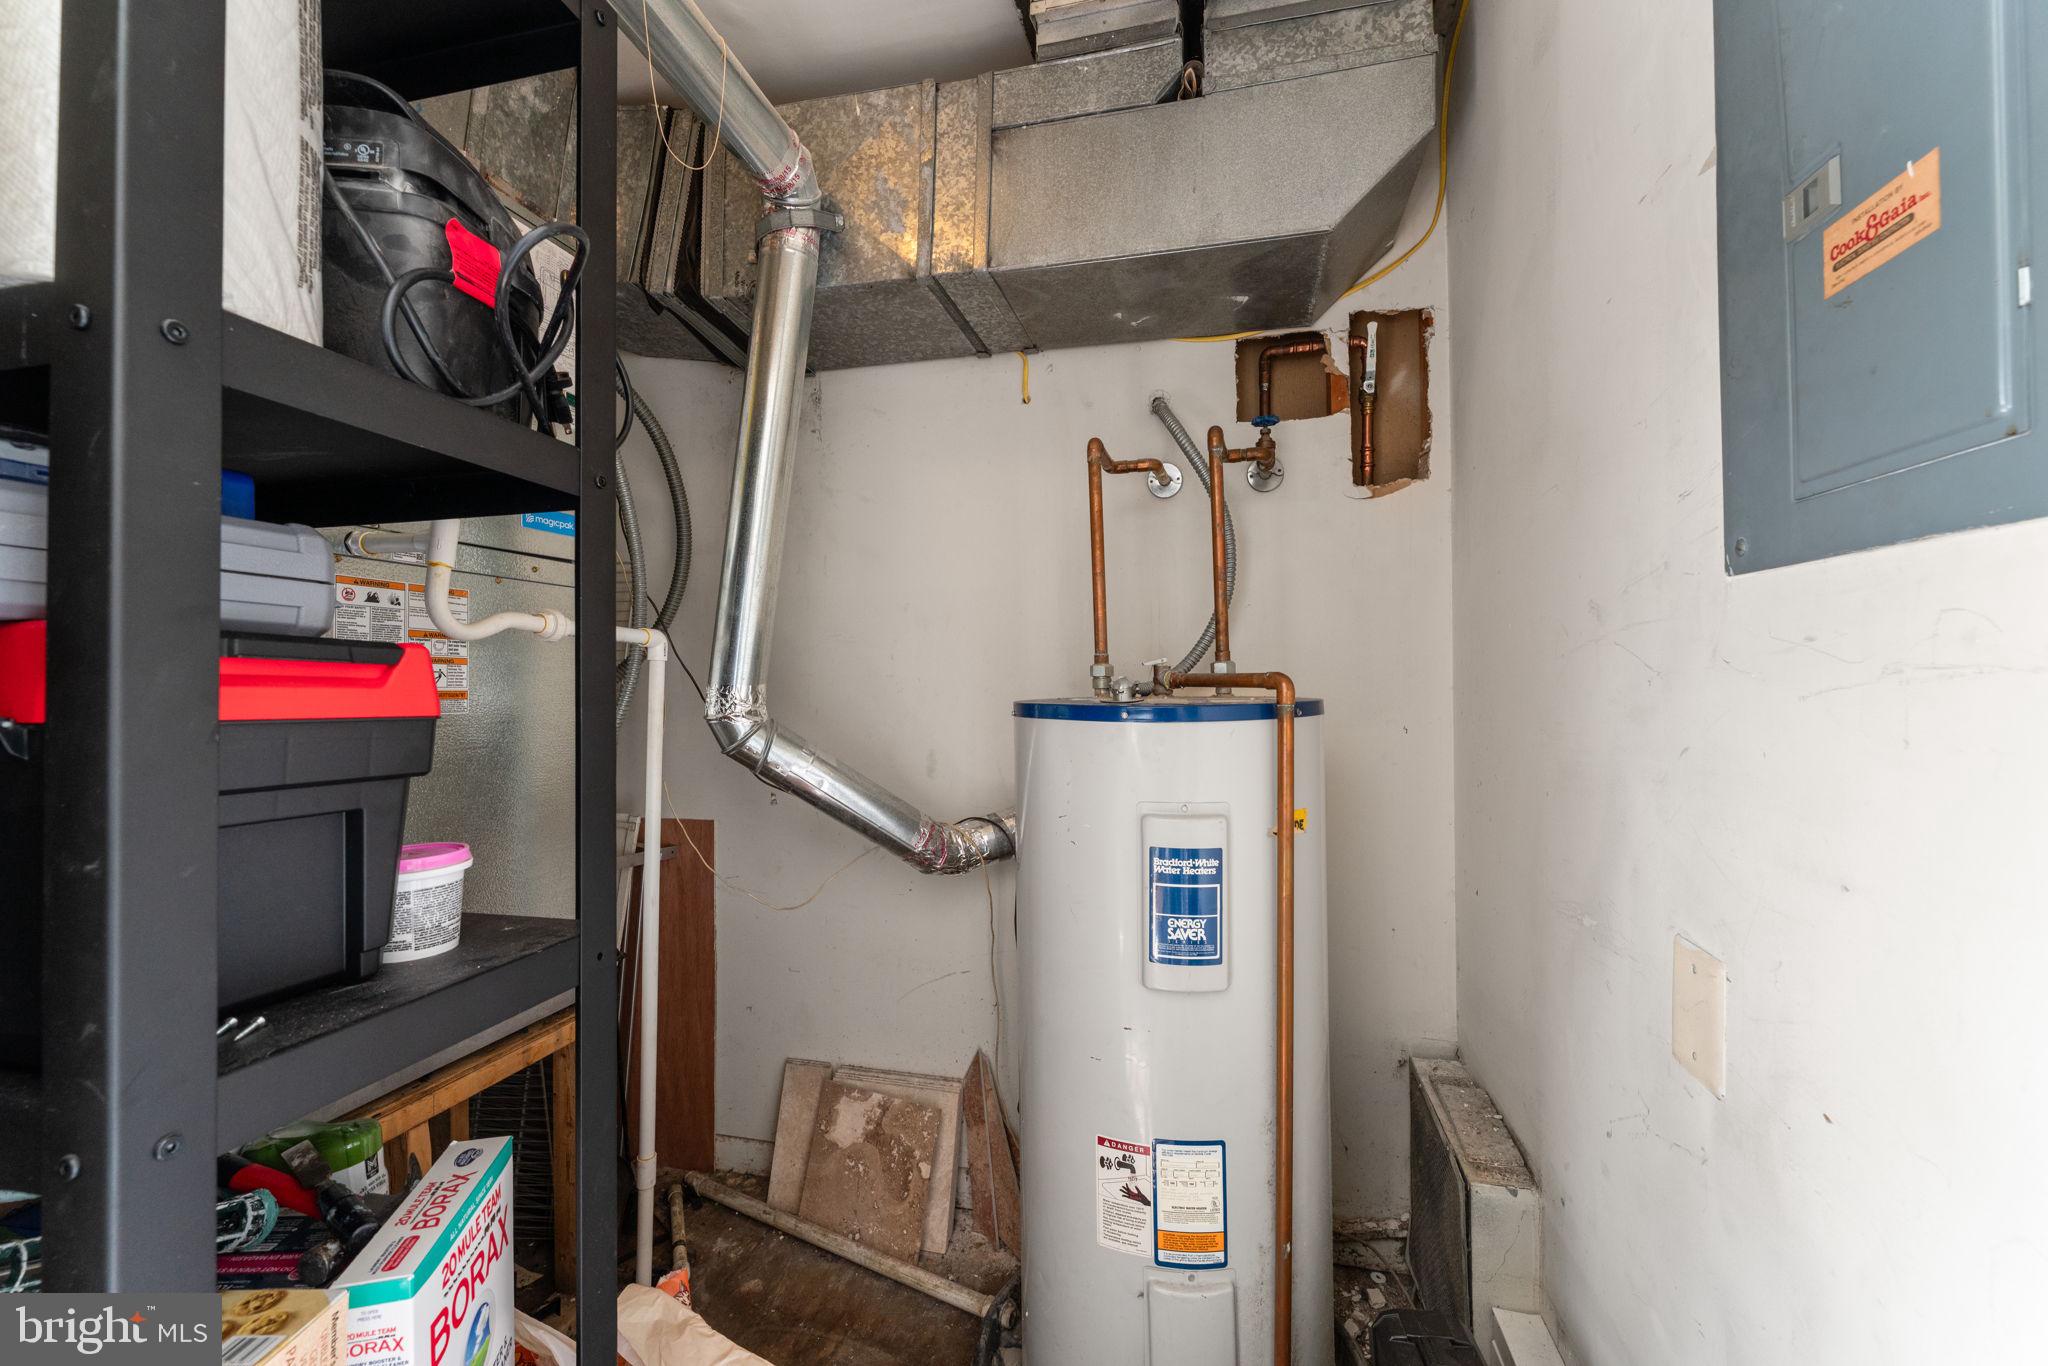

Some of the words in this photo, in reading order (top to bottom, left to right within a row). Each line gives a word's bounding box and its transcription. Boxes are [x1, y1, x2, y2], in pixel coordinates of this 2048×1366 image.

[535, 516, 574, 529] magicpak
[360, 580, 389, 588] WARNING
[1154, 865, 1181, 874] Water
[1183, 867, 1216, 875] Heaters
[1168, 918, 1207, 928] ENERGY
[1168, 928, 1207, 940] SAVER
[1111, 1141, 1145, 1153] DANGER
[410, 1171, 478, 1231] BORAX
[395, 1215, 411, 1226] 20
[441, 1253, 457, 1289] 20
[457, 1215, 482, 1262] MULE
[482, 1184, 502, 1223] TEAM
[430, 1203, 509, 1366] BORAX
[356, 1330, 376, 1338] MULE
[378, 1327, 396, 1335] TEAM
[347, 1337, 404, 1357] ORAX
